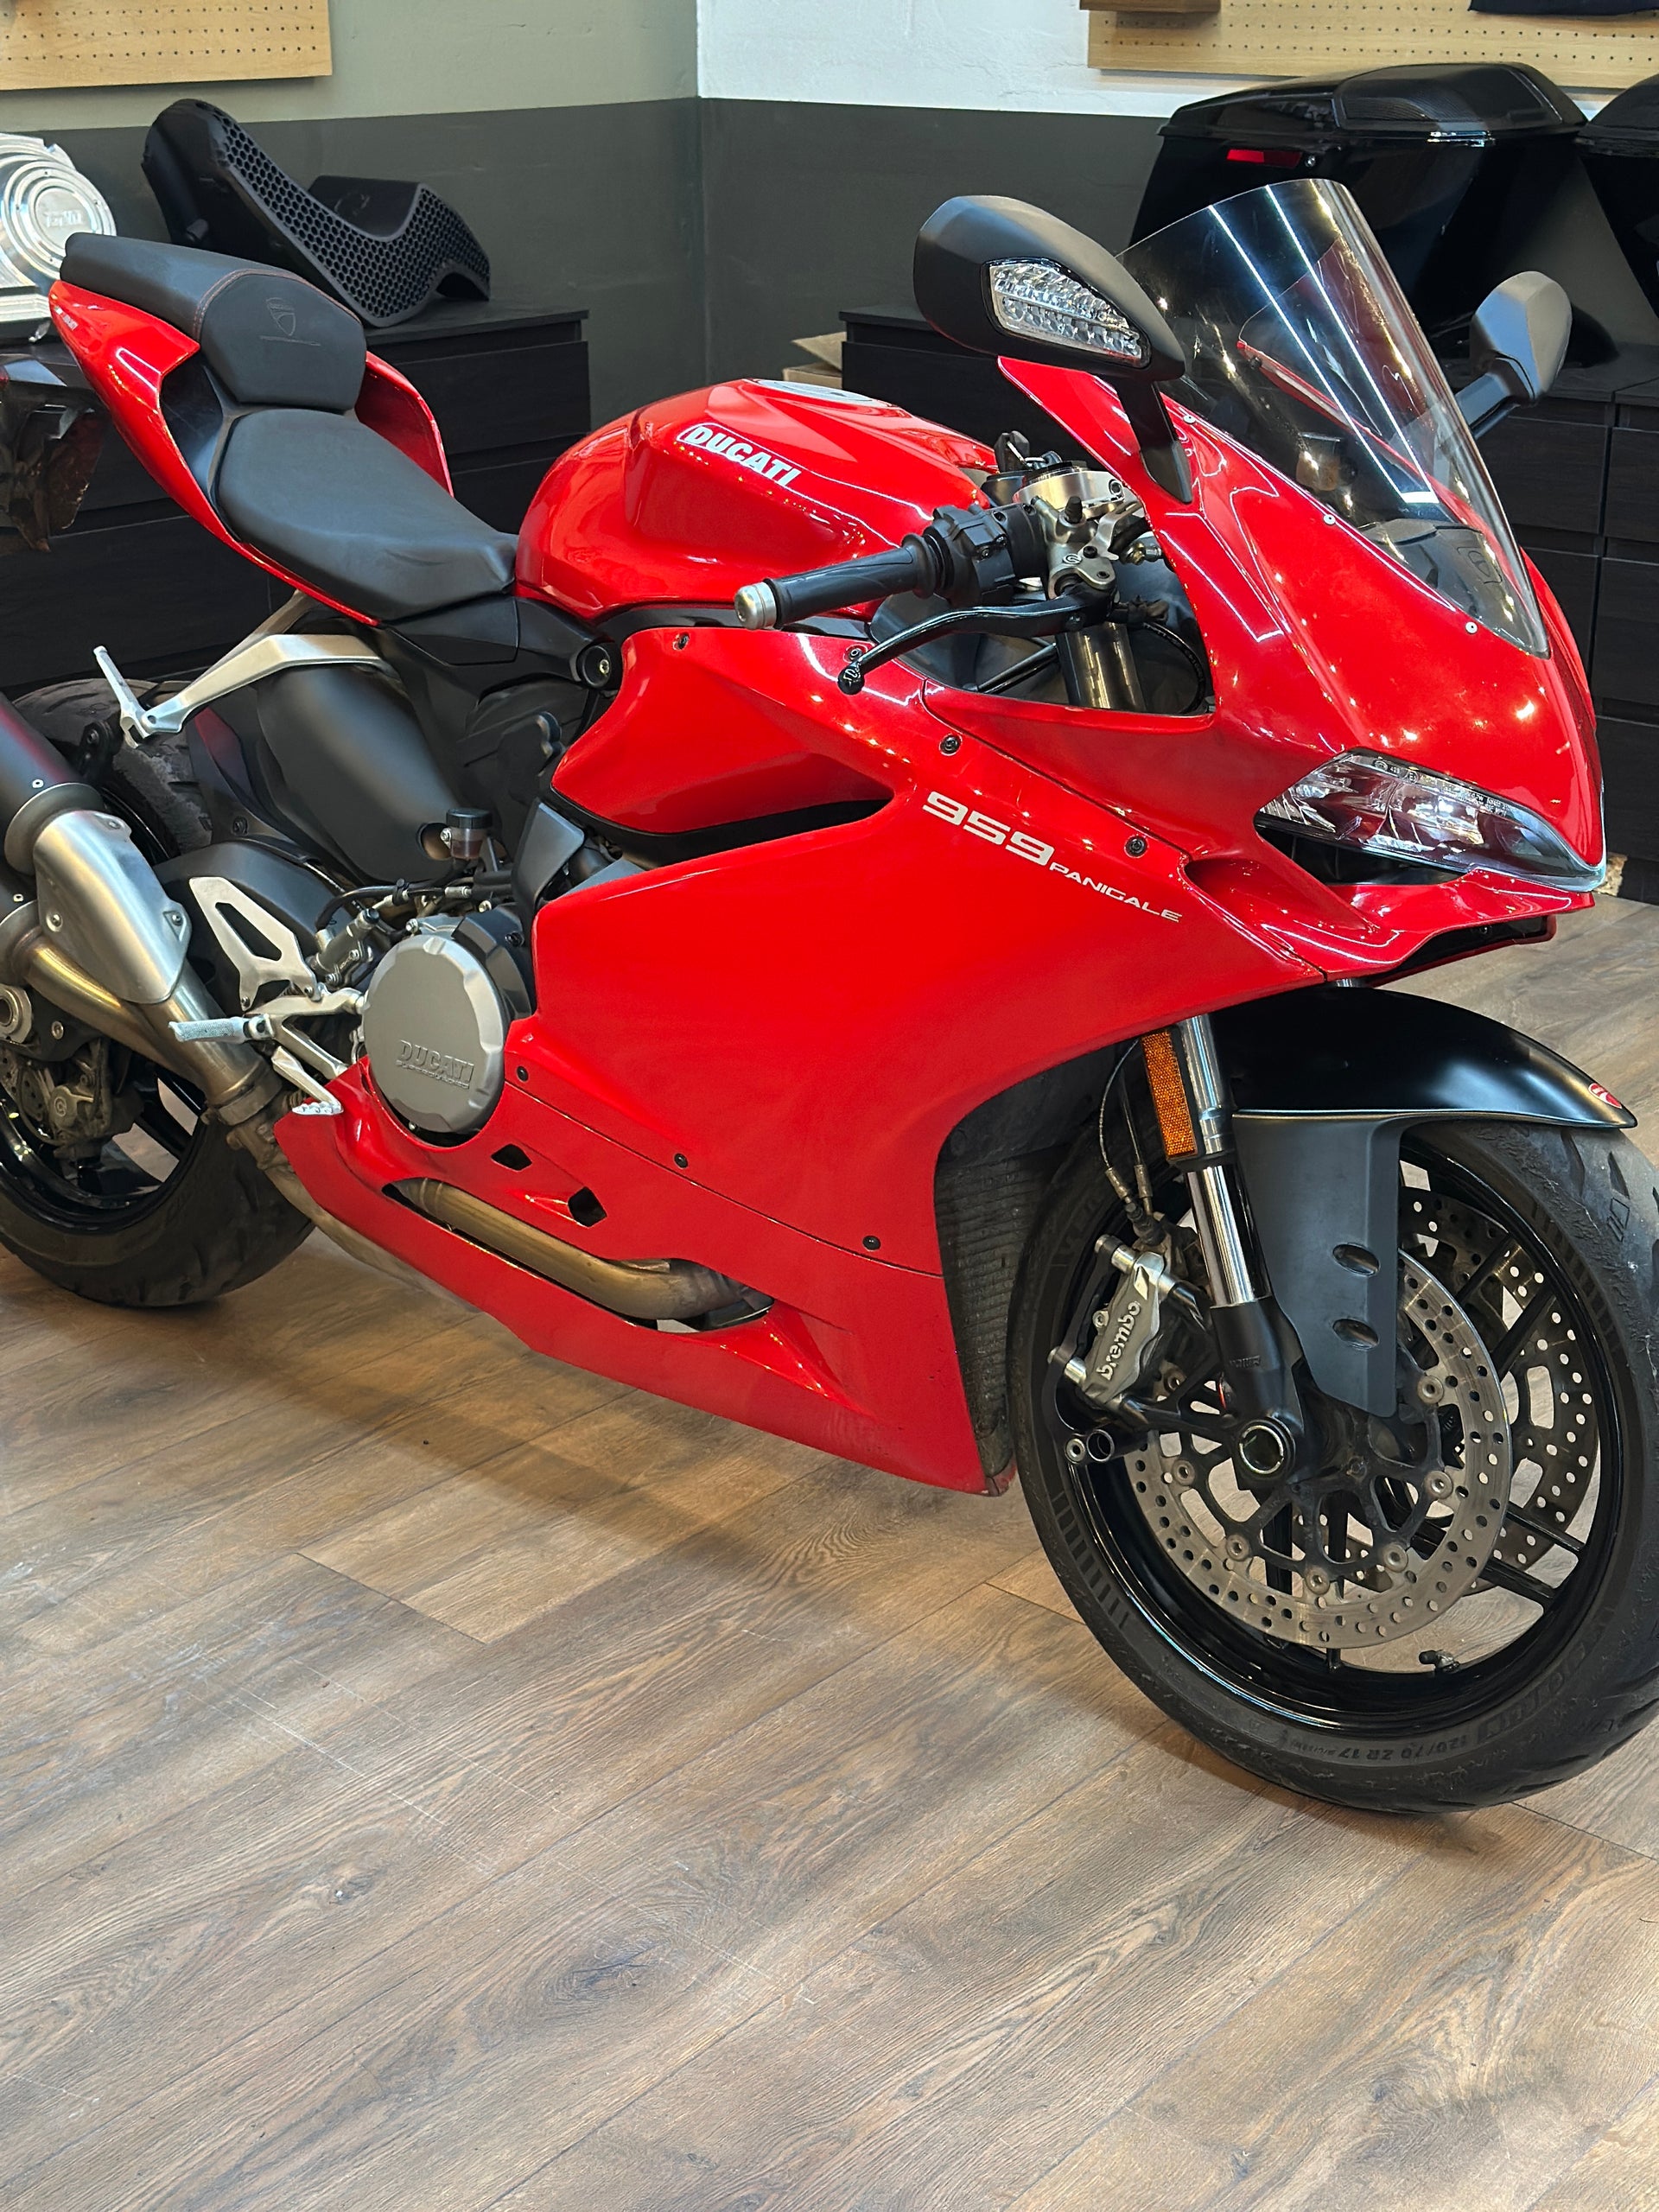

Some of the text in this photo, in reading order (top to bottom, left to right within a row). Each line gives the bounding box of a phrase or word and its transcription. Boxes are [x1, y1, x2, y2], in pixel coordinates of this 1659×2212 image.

[683, 426, 802, 486] DUCATI
[922, 791, 1183, 923] 959 PANIGALE
[398, 1039, 474, 1083] DUCATI
[1096, 1300, 1141, 1381] brembo
[1338, 1747, 1361, 1759] 17
[1366, 1749, 1394, 1761] ZR
[1400, 1734, 1467, 1759] 120/70
